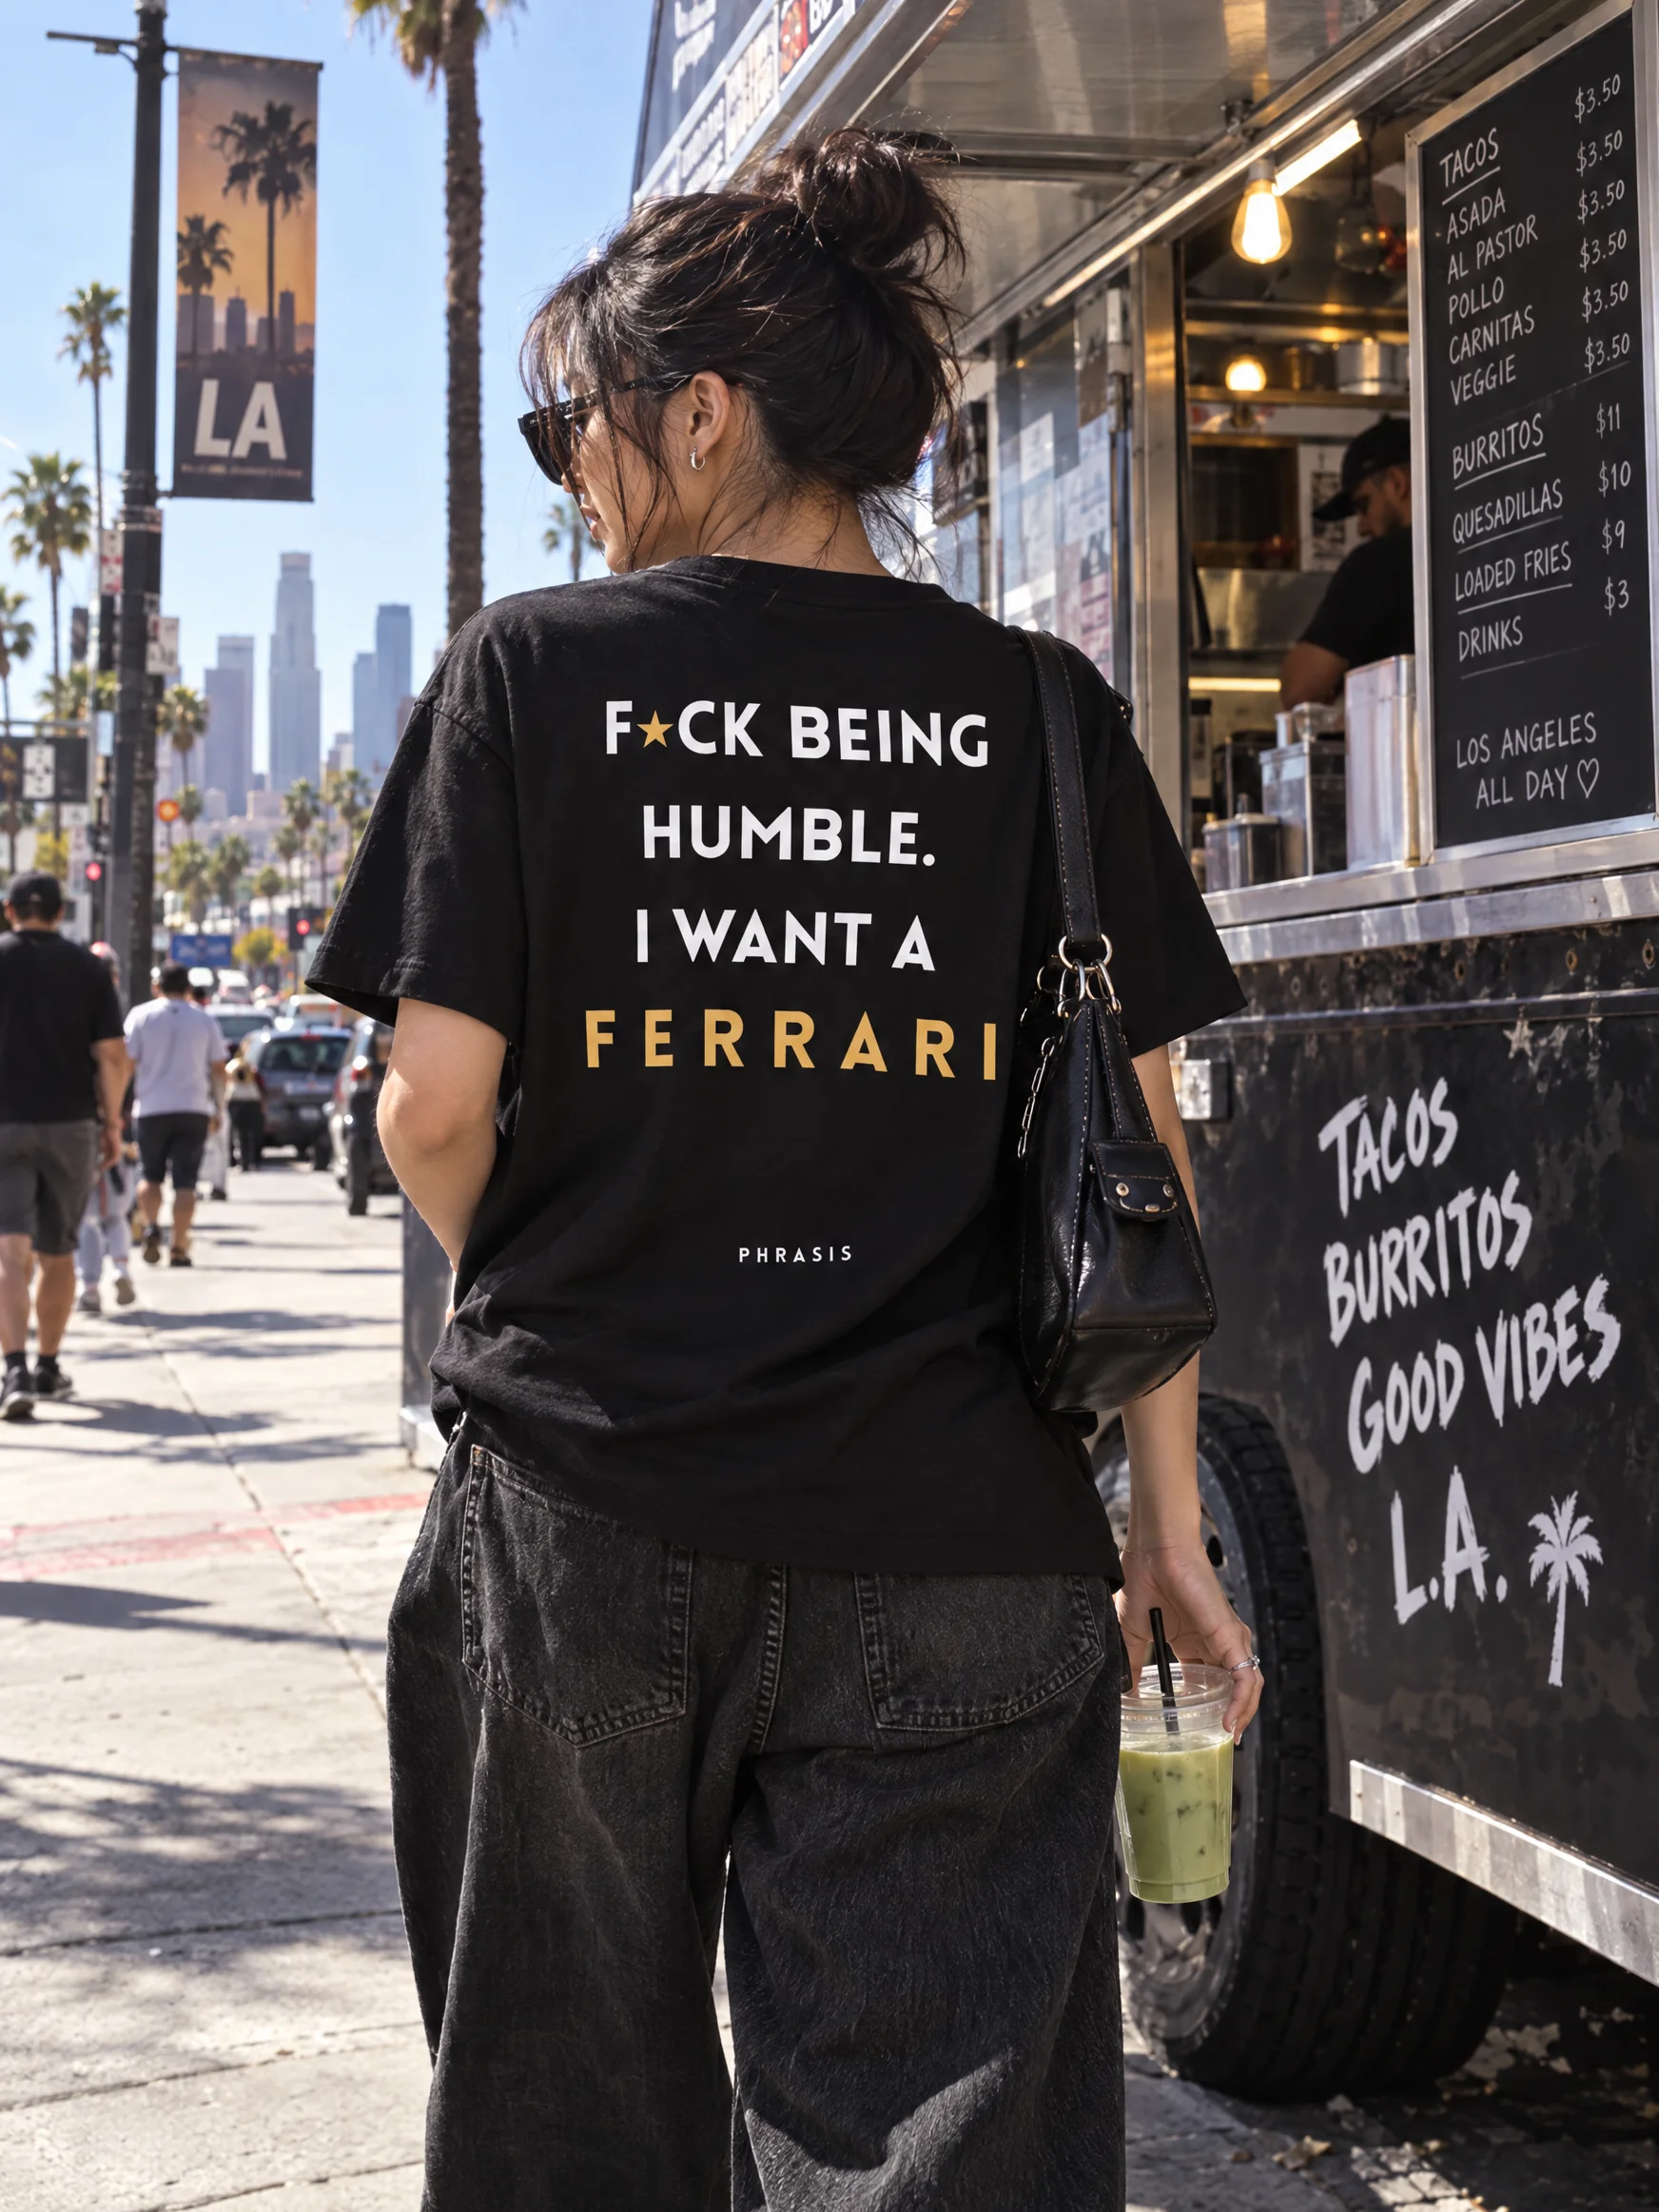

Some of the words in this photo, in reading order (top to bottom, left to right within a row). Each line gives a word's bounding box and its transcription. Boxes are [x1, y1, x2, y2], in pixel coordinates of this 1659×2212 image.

[1574, 73, 1621, 124] $3.50
[1440, 127, 1500, 188] TACOS
[1575, 129, 1623, 177] $3.50
[1447, 187, 1507, 245] ASADA
[1577, 179, 1625, 225] $3.50
[1447, 251, 1469, 284] AL
[1476, 214, 1538, 270] PASTOR
[1579, 228, 1627, 273] $3.50
[1448, 276, 1505, 324] POLLO
[1581, 280, 1629, 323] $3.50
[1449, 305, 1535, 365] CARNITAS
[1584, 332, 1630, 374] $3.50
[1450, 354, 1516, 406] VEGGIE
[195, 379, 287, 460] LA
[1453, 413, 1545, 480] BURRITOS
[1596, 402, 1620, 439] $11
[1598, 460, 1631, 498] $10
[1453, 478, 1563, 545] QUESADILLAS
[1602, 519, 1626, 555] $9
[1455, 558, 1516, 602] LOADED
[1524, 540, 1571, 581] FRIES
[1604, 577, 1630, 617] $3
[1458, 615, 1523, 662] DRINKS
[790, 705, 988, 768] BEING
[1456, 734, 1491, 769] LOS
[1501, 712, 1598, 760] ANGELES
[1475, 776, 1514, 810] ALL
[1526, 764, 1569, 801] DAY
[643, 805, 936, 867] HUMBLE.
[636, 909, 649, 963] I
[672, 909, 873, 967] WANT
[891, 915, 936, 971] A
[585, 1008, 997, 1081] FERRARI
[1318, 1077, 1458, 1218] TACOS
[738, 1245, 852, 1263] PHRASIS
[1324, 1169, 1532, 1347] BURRITOS
[1347, 1340, 1465, 1475] GOOD
[1476, 1273, 1621, 1427] VIBES
[1391, 1465, 1508, 1625] L.A.
